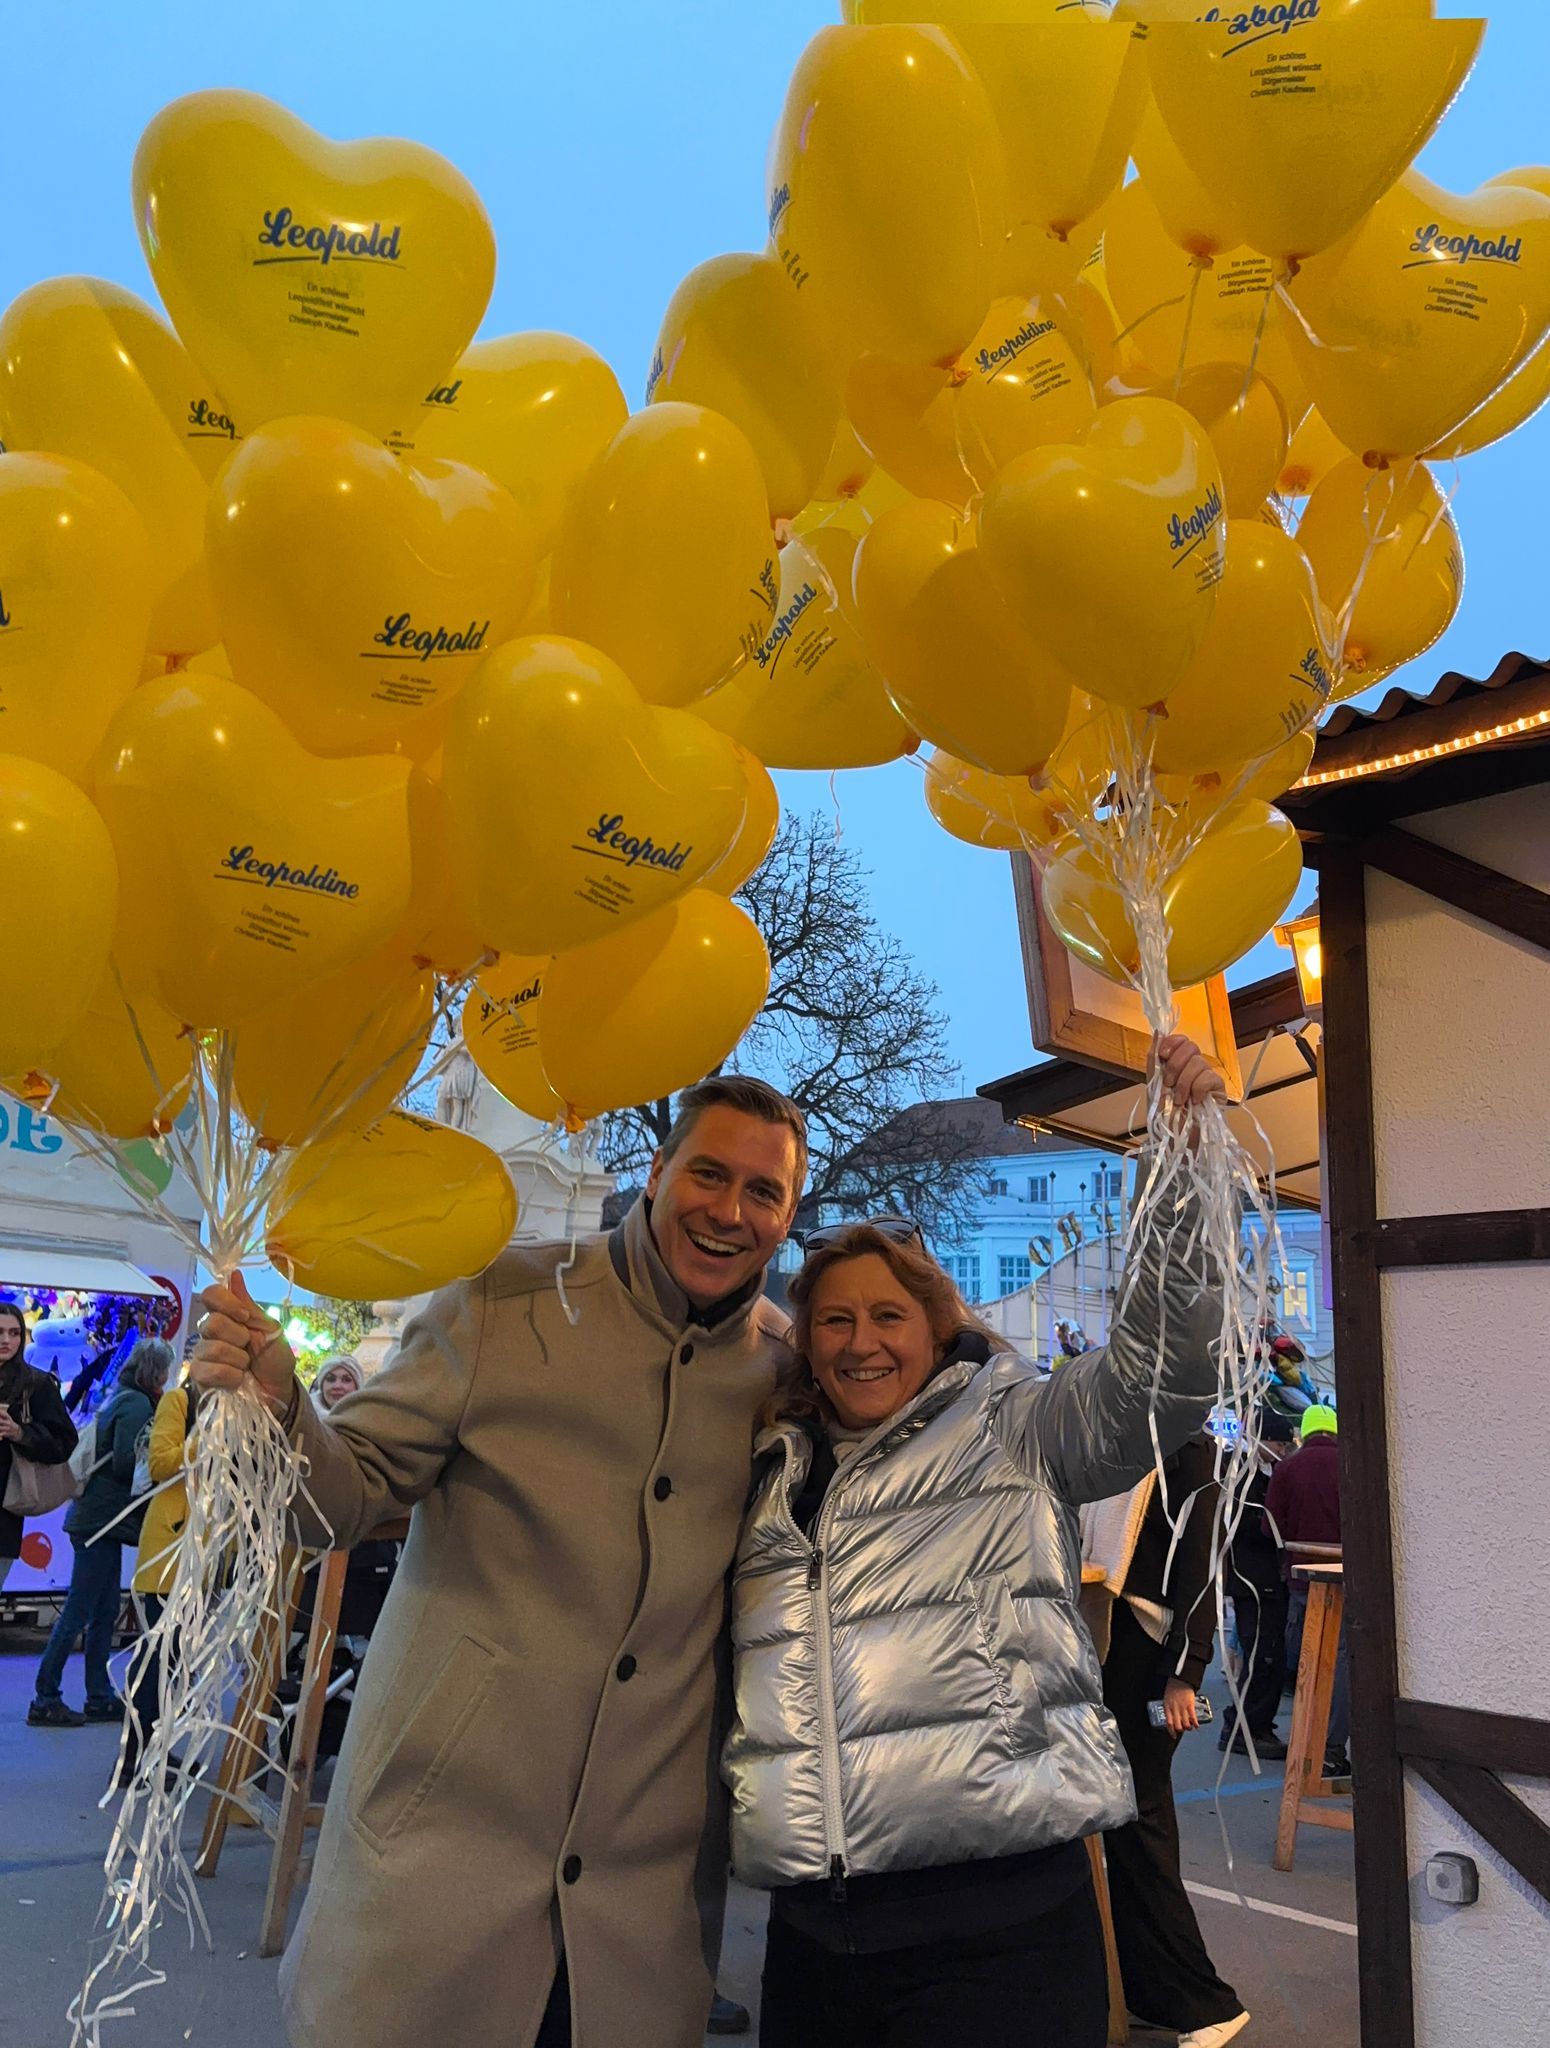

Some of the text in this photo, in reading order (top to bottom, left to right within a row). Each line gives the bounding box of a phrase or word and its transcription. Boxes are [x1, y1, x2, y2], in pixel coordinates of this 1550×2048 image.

[258, 207, 401, 264] Leopold
[1410, 224, 1521, 264] Leopold
[975, 320, 1057, 374] Leopoldine
[1167, 481, 1222, 550] Leopold
[373, 612, 490, 662] Leopold
[753, 582, 817, 669] Leopold
[587, 813, 693, 871] Leopold
[220, 845, 360, 899] Leopoldine
